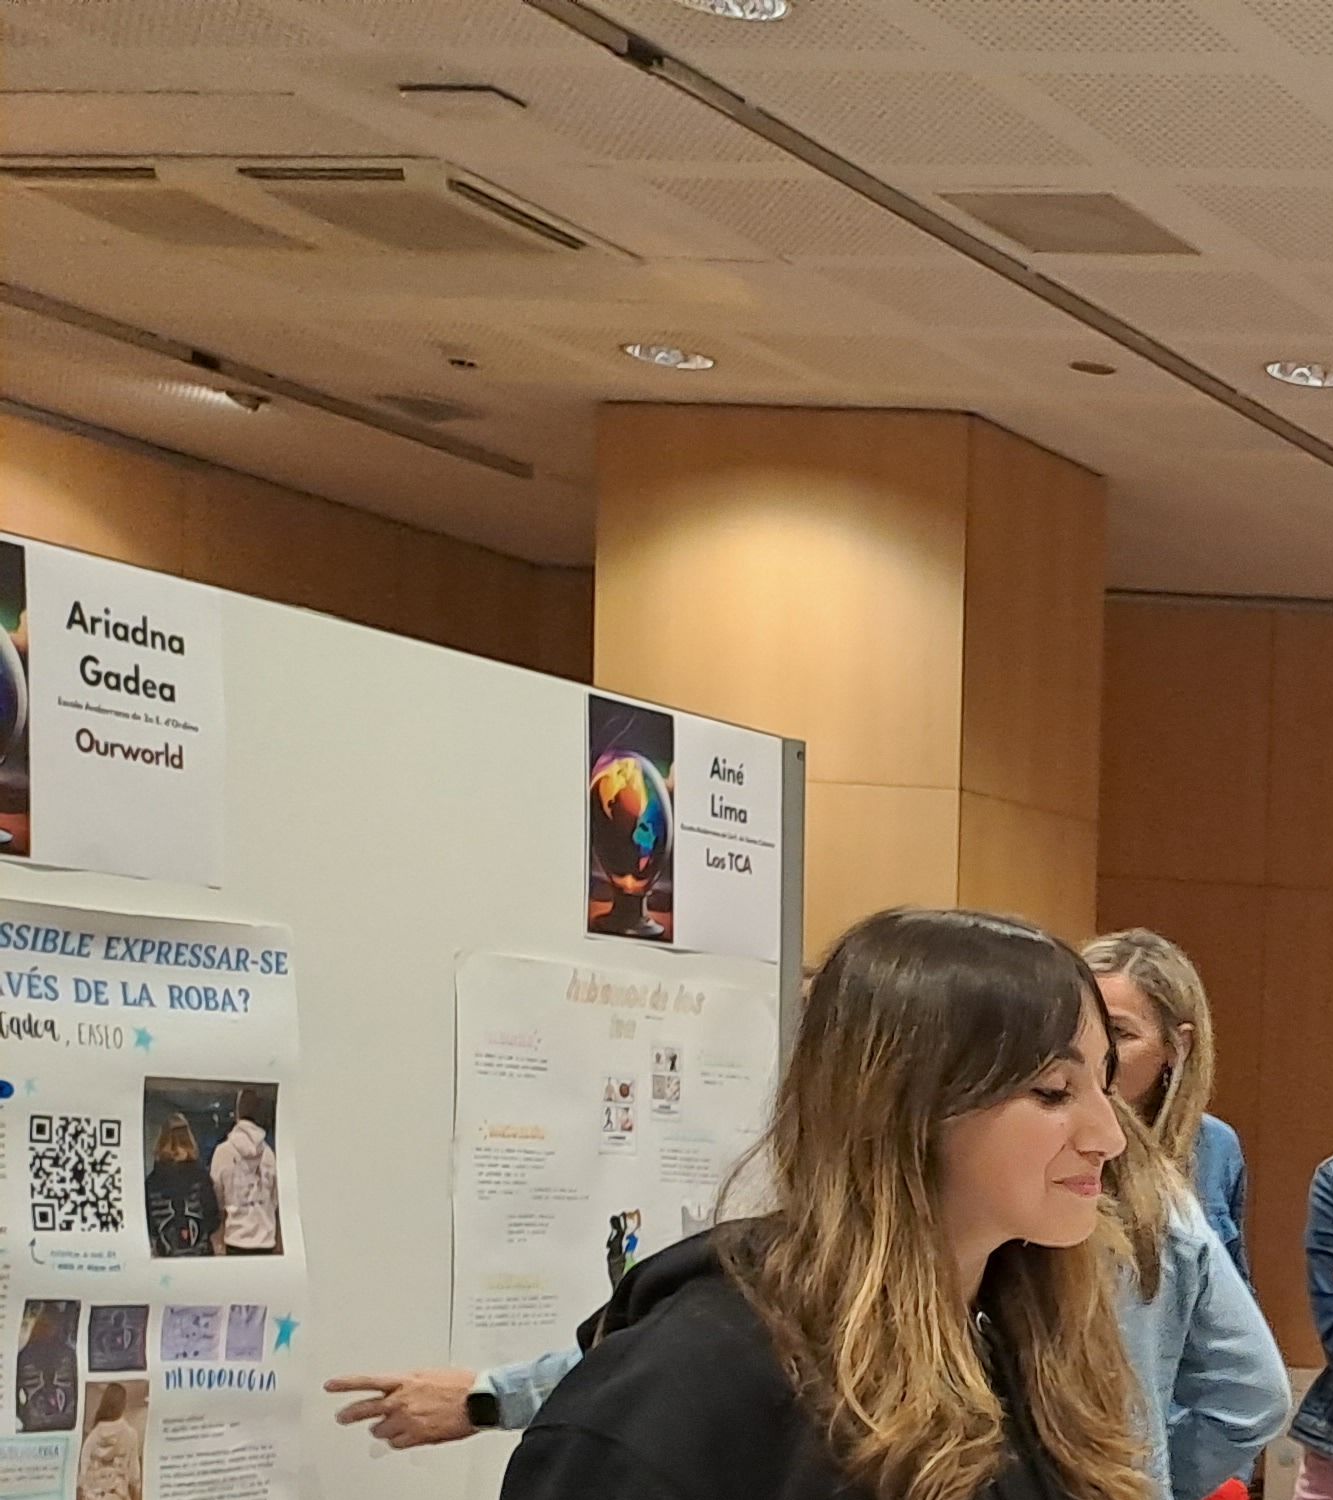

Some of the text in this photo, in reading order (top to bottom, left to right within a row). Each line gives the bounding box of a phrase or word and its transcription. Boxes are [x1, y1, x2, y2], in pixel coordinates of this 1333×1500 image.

[66, 600, 185, 656] Ariadna
[79, 654, 176, 703] Gadea
[75, 727, 184, 770] Ourworld
[709, 756, 745, 786] Ainé
[711, 793, 748, 824] Lima
[728, 851, 753, 875] TCA
[103, 935, 289, 976] EXPRESSAR-SE
[0, 965, 251, 1013] VÉS DE LA ROBA?
